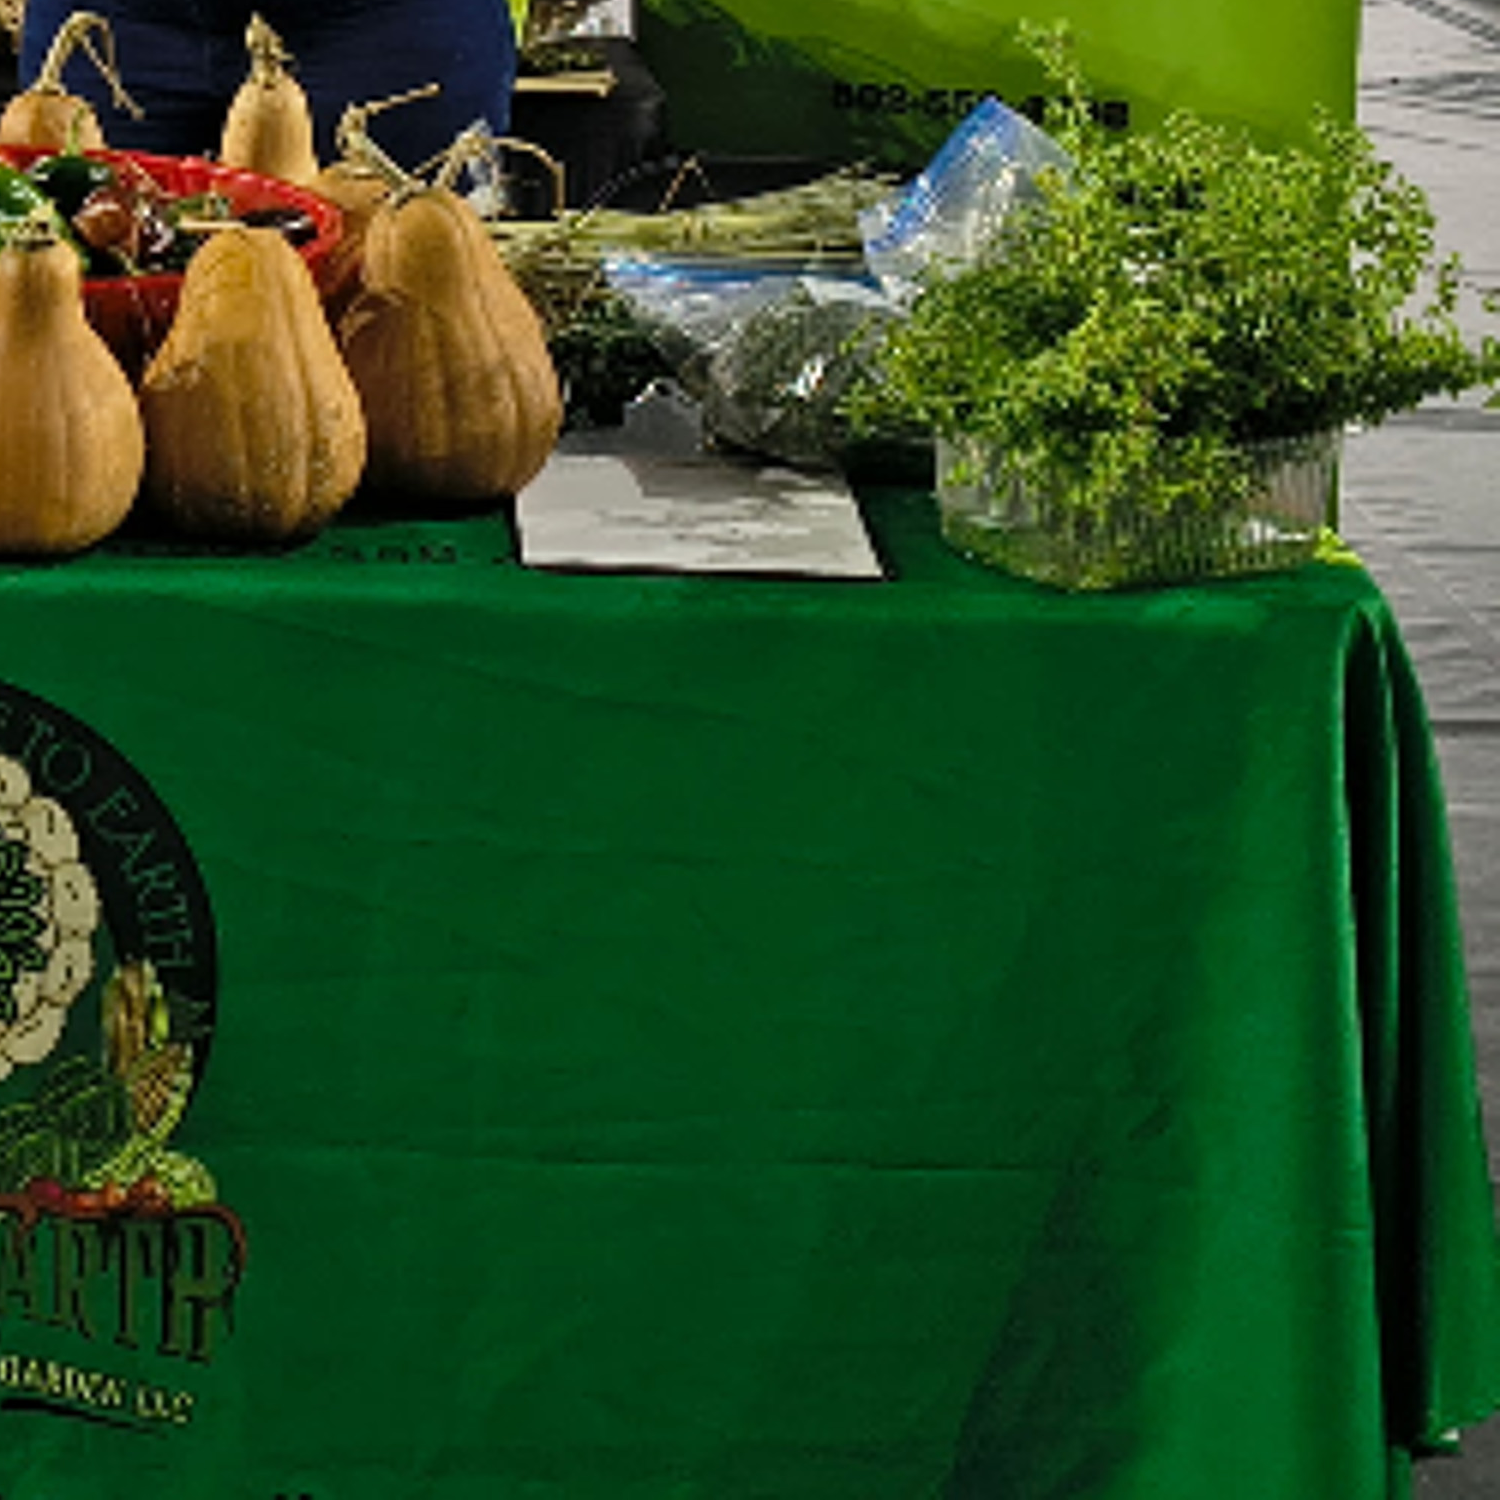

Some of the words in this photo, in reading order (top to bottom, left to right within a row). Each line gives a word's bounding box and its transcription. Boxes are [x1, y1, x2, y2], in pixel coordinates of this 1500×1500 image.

[20, 715, 92, 794] TO
[88, 787, 196, 971] EARTH
[0, 1354, 126, 1407] GARDEN
